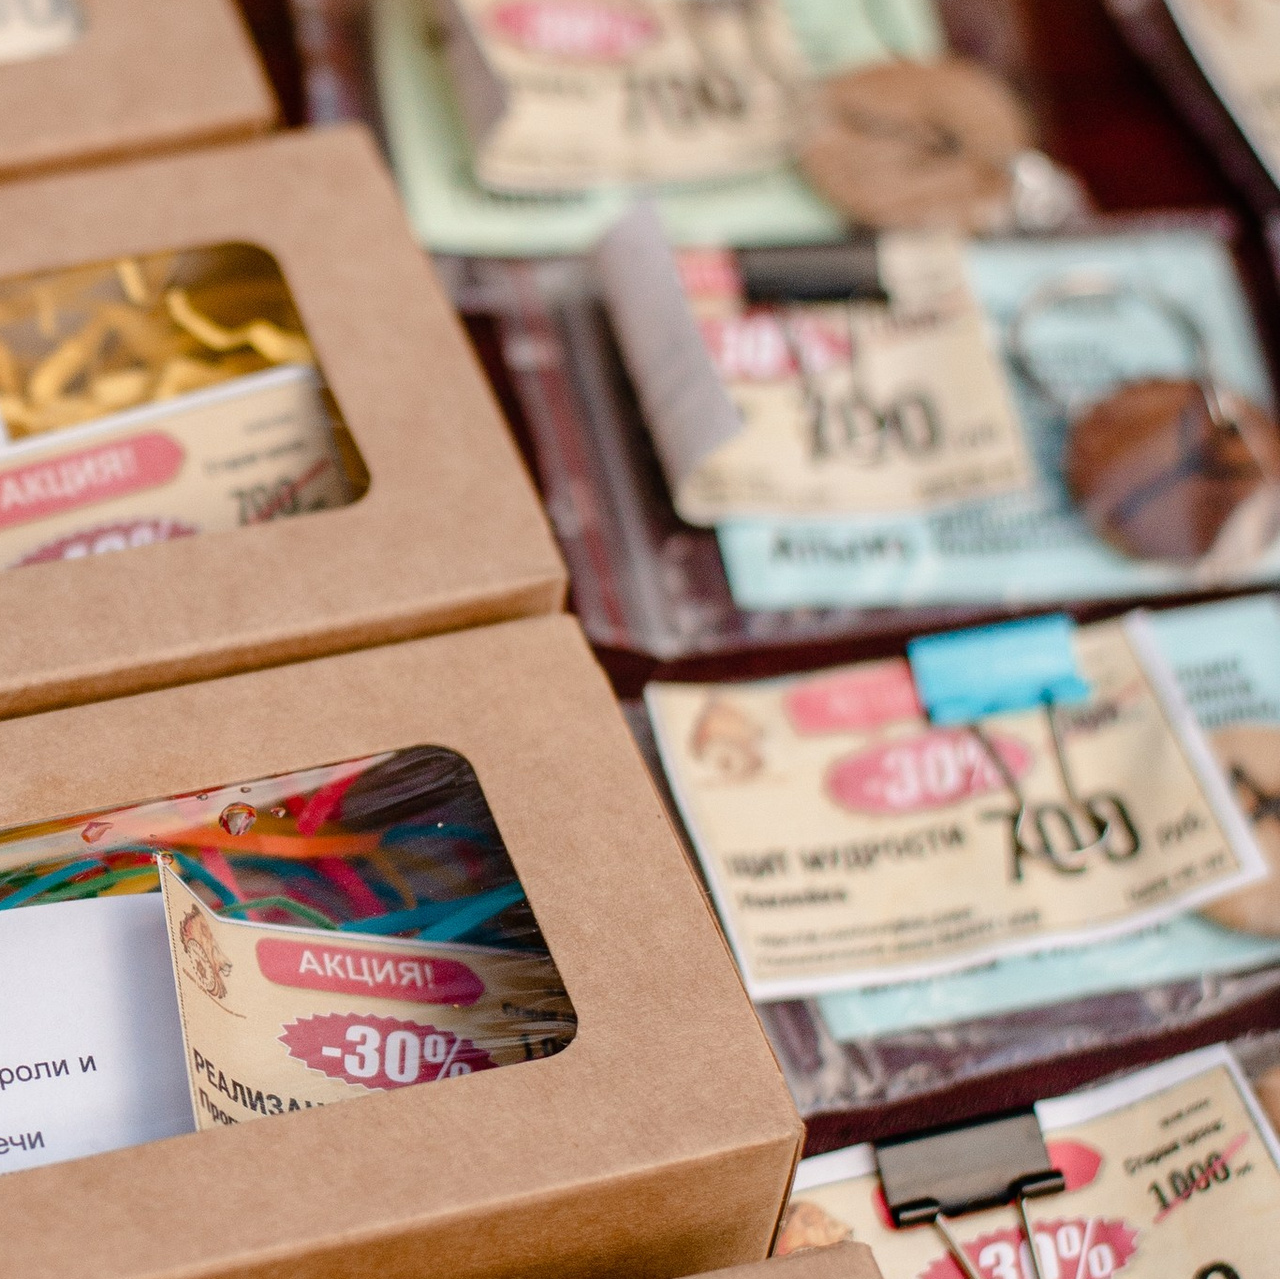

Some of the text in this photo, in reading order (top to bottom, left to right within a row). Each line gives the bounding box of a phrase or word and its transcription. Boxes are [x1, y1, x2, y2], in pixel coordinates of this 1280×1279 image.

[299, 950, 435, 989] АКЦИЯ!
[78, 1053, 98, 1074] и
[321, 1024, 472, 1083] -30%
[1147, 1150, 1231, 1212] 1000
